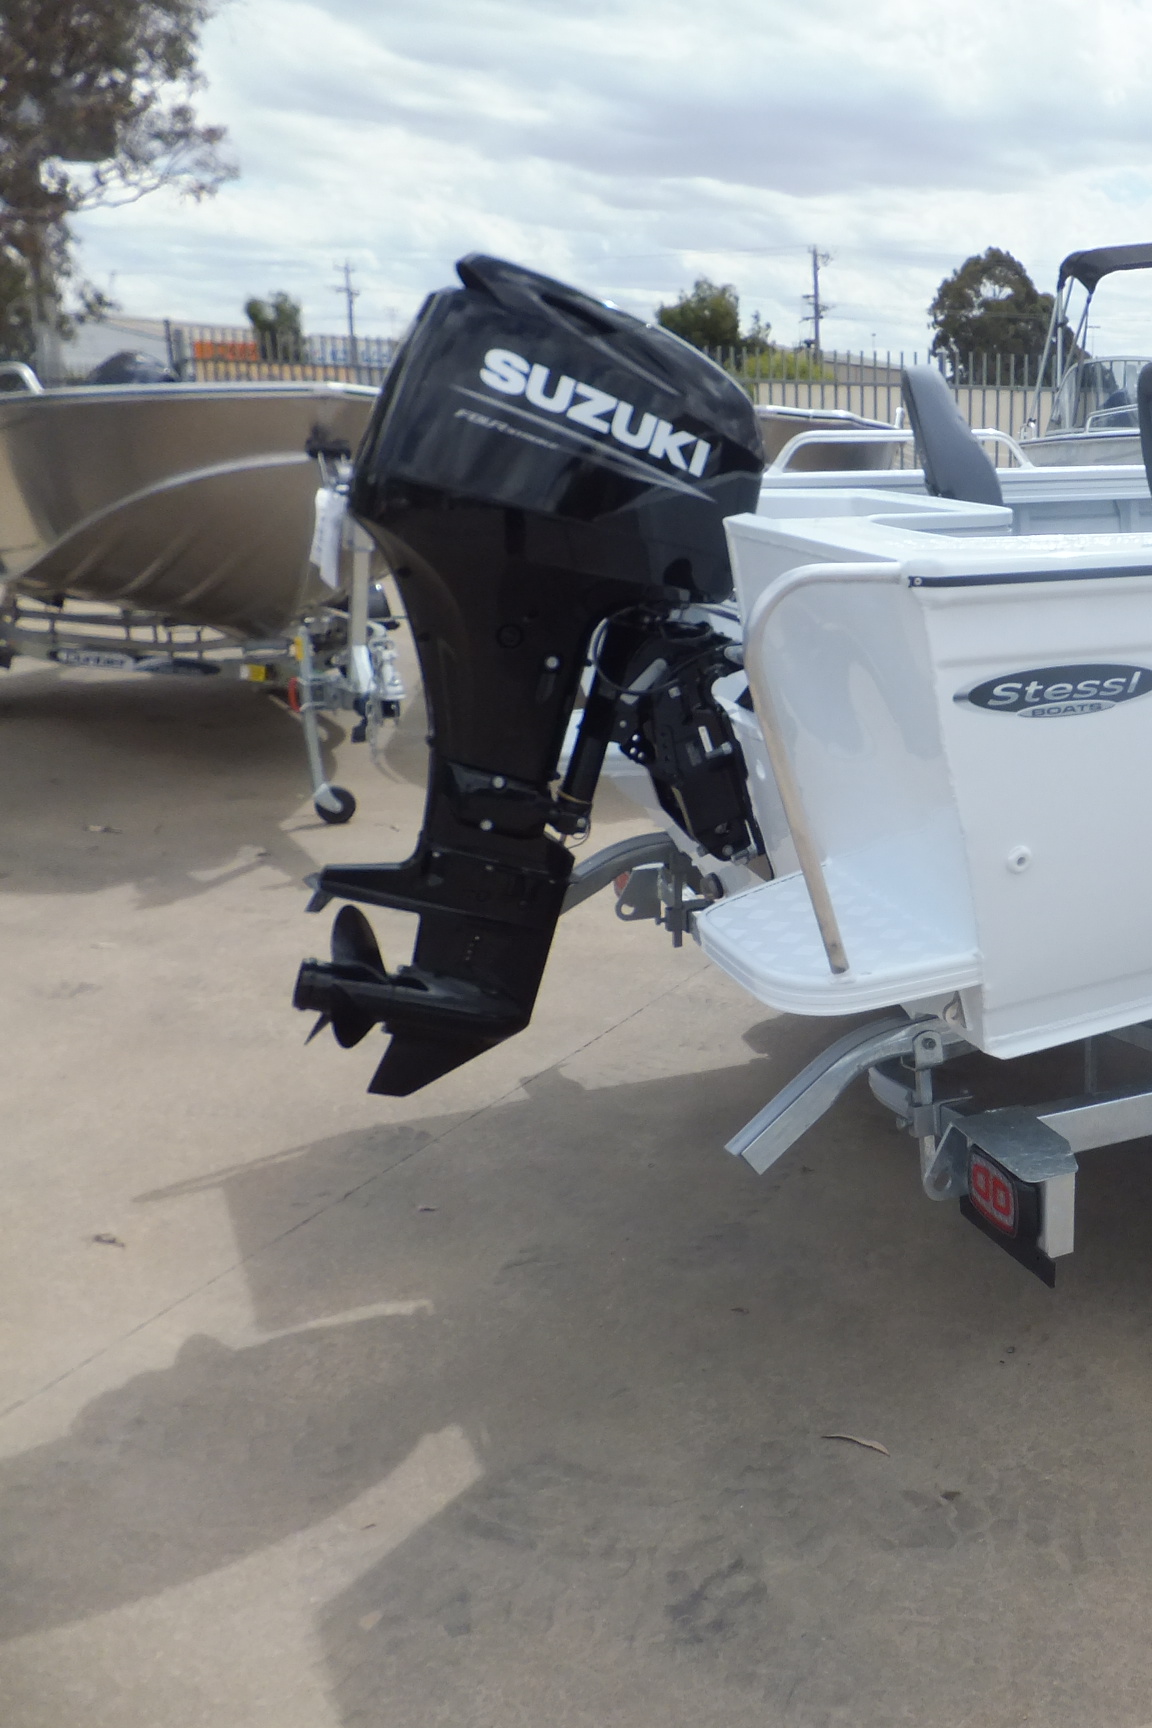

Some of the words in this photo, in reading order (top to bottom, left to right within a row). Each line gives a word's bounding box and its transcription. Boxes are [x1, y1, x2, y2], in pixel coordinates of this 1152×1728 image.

[479, 348, 712, 478] SUZUKI
[987, 670, 1142, 706] Stessl
[1031, 702, 1102, 717] BOATS
